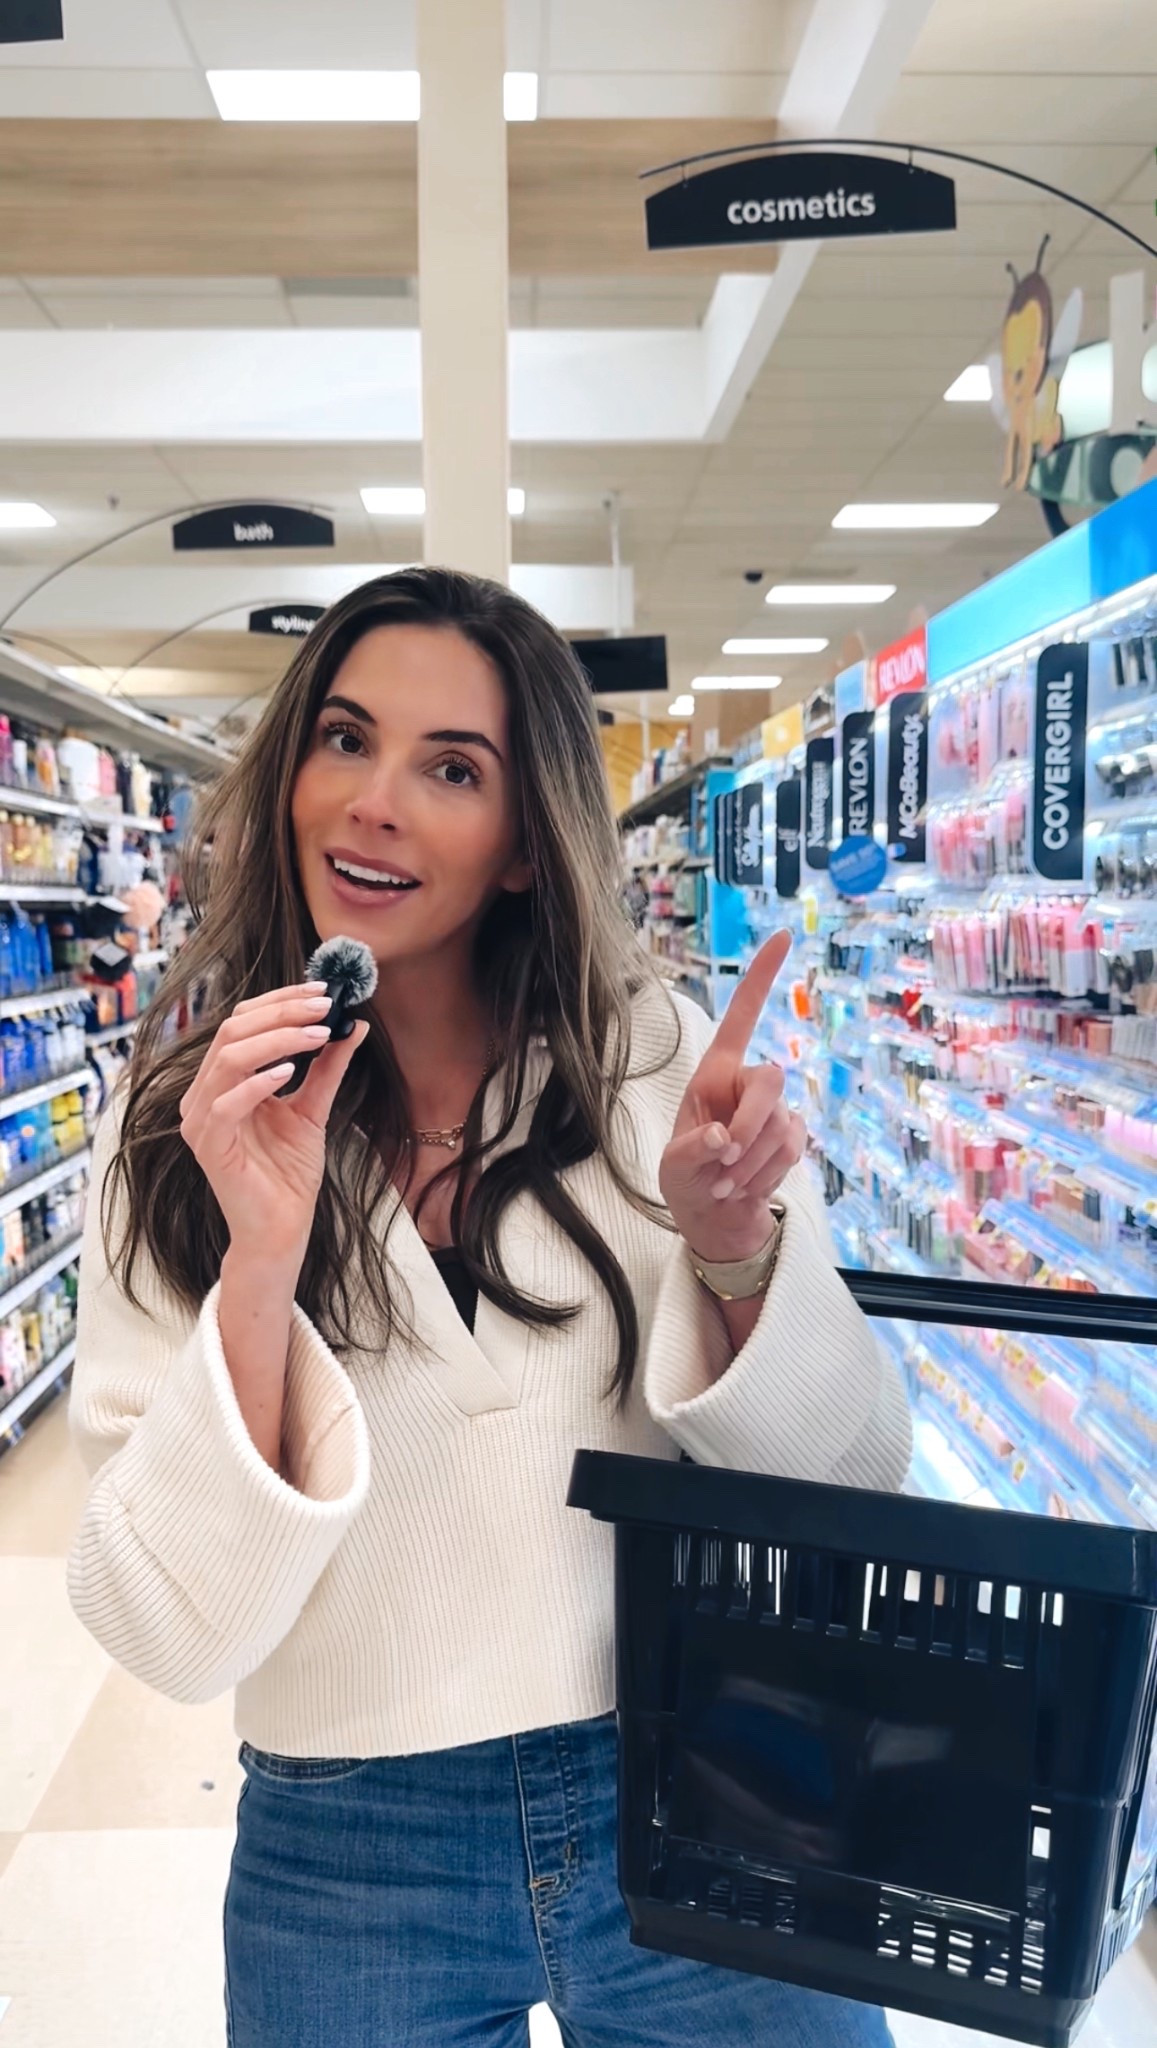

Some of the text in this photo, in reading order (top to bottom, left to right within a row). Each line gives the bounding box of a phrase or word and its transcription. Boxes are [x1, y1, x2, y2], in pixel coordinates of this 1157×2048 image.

[726, 187, 876, 225] cosmetics
[233, 521, 274, 541] bath
[879, 644, 925, 691] REVLON
[1042, 671, 1074, 850] COVERGIRL
[848, 737, 869, 836] REVLON
